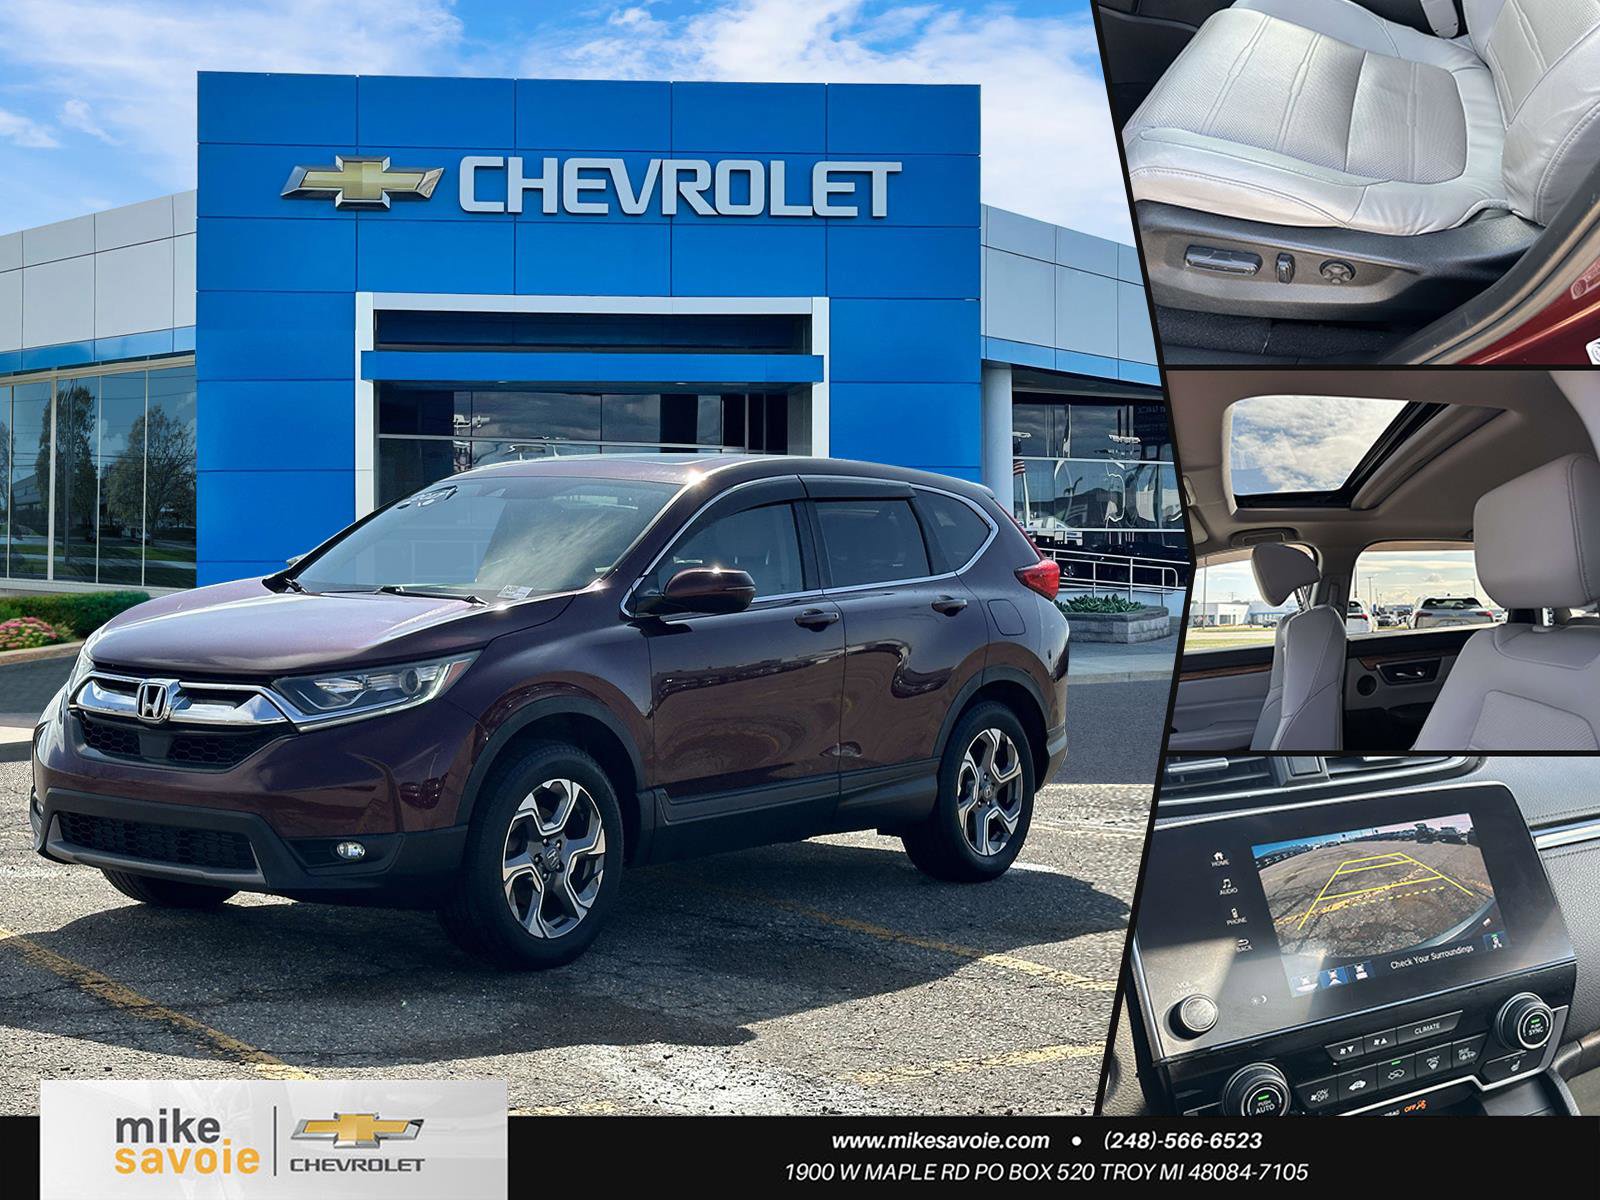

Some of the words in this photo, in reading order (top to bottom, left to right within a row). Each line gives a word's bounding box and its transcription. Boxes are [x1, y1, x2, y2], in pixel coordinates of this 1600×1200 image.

[459, 155, 902, 218] CHEVROLET
[1219, 887, 1238, 896] AUDIO
[1226, 916, 1247, 926] PHONE
[1390, 958, 1413, 969] Check
[1413, 955, 1430, 964] Your
[1430, 945, 1474, 960] Surroundings
[1414, 1022, 1441, 1035] CLIMATE
[1256, 1103, 1275, 1115] AUTO
